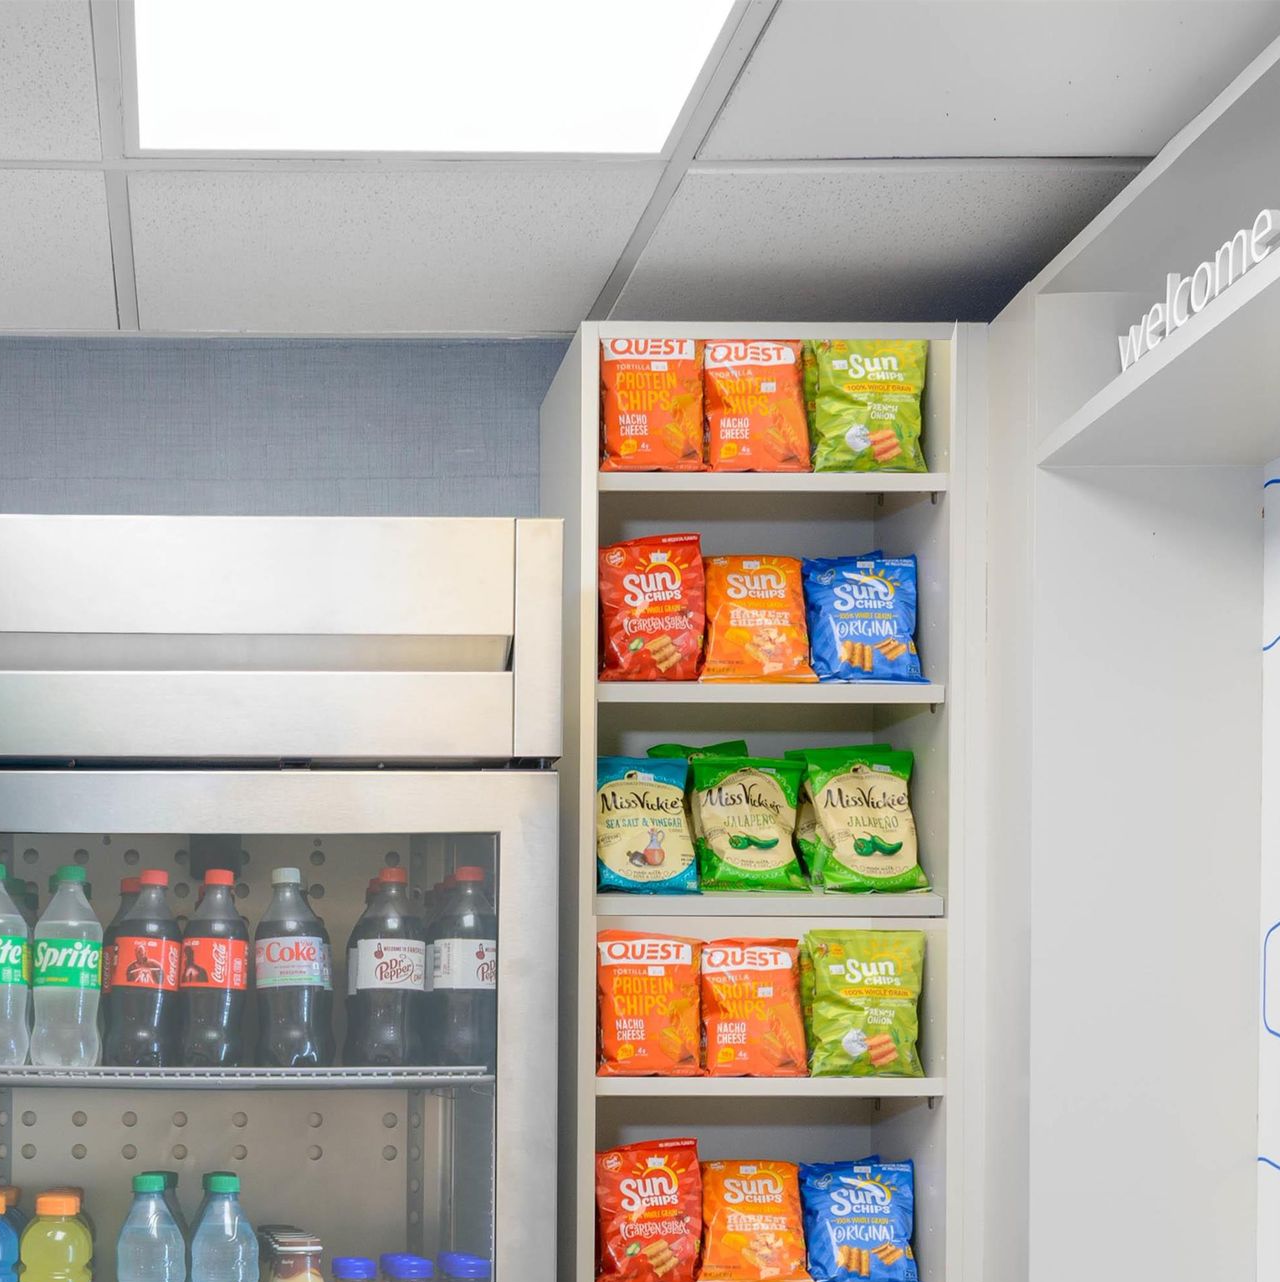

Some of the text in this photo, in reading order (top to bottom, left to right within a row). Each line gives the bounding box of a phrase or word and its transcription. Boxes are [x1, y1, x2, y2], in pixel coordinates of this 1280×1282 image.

[609, 338, 688, 356] QUEST
[710, 345, 784, 363] QUEST
[848, 353, 900, 379] Sun
[616, 371, 677, 391] PROTEIN
[867, 371, 903, 382] CHIPS
[616, 390, 671, 412] CHIPS
[618, 414, 648, 425] NACHO
[720, 417, 750, 428] NACHO
[619, 425, 649, 436] CHEESE
[720, 428, 750, 440] CHEESE
[623, 571, 682, 607] Sun
[727, 573, 787, 599] Sun
[747, 589, 786, 599] CHIPS
[645, 590, 682, 601] CHIPS
[833, 582, 895, 611] Sun
[855, 600, 894, 609] CHIPS
[600, 791, 638, 812] Miss
[34, 941, 99, 973] Sprite
[265, 940, 318, 963] Coke
[607, 942, 685, 960] QUEST
[706, 949, 781, 967] QUEST
[376, 961, 412, 982] Pepper
[845, 958, 896, 985] Sun
[613, 976, 674, 995] PROTEIN
[864, 976, 901, 987] CHIPS
[614, 995, 669, 1017] CHIPS
[615, 1019, 644, 1031] NACHO
[716, 1023, 746, 1034] NACHO
[616, 1030, 646, 1042] CHEESE
[716, 1033, 746, 1045] CHEESE
[621, 1176, 680, 1212] Sun
[723, 1176, 783, 1204] Sun
[642, 1194, 680, 1205] CHIPS
[830, 1184, 891, 1215] Sun
[852, 1204, 891, 1214] CHIPS
